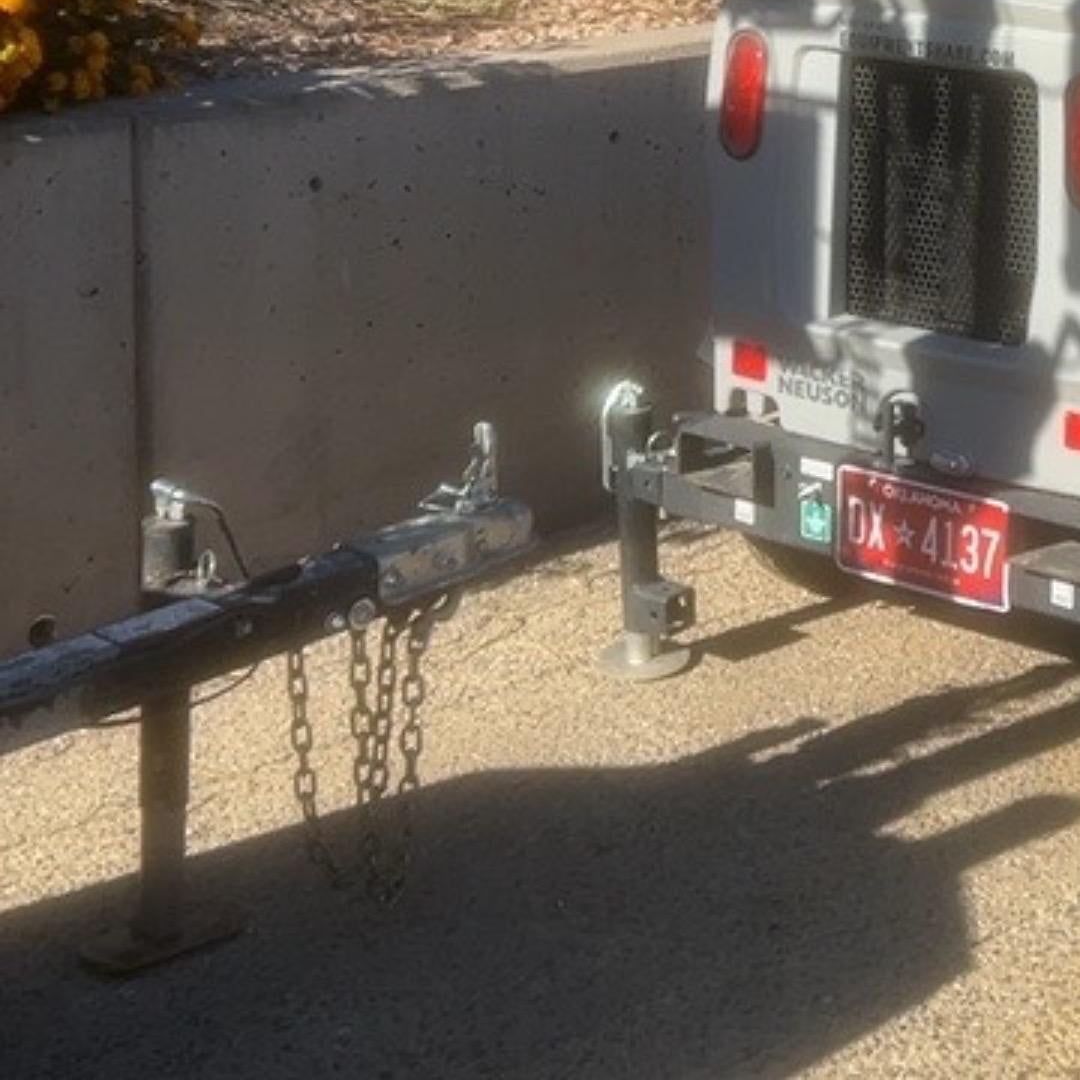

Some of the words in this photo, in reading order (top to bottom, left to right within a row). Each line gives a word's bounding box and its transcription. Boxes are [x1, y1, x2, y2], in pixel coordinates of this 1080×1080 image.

[776, 374, 869, 415] NEUSON
[848, 495, 886, 553] DX
[920, 515, 1001, 580] 4137
